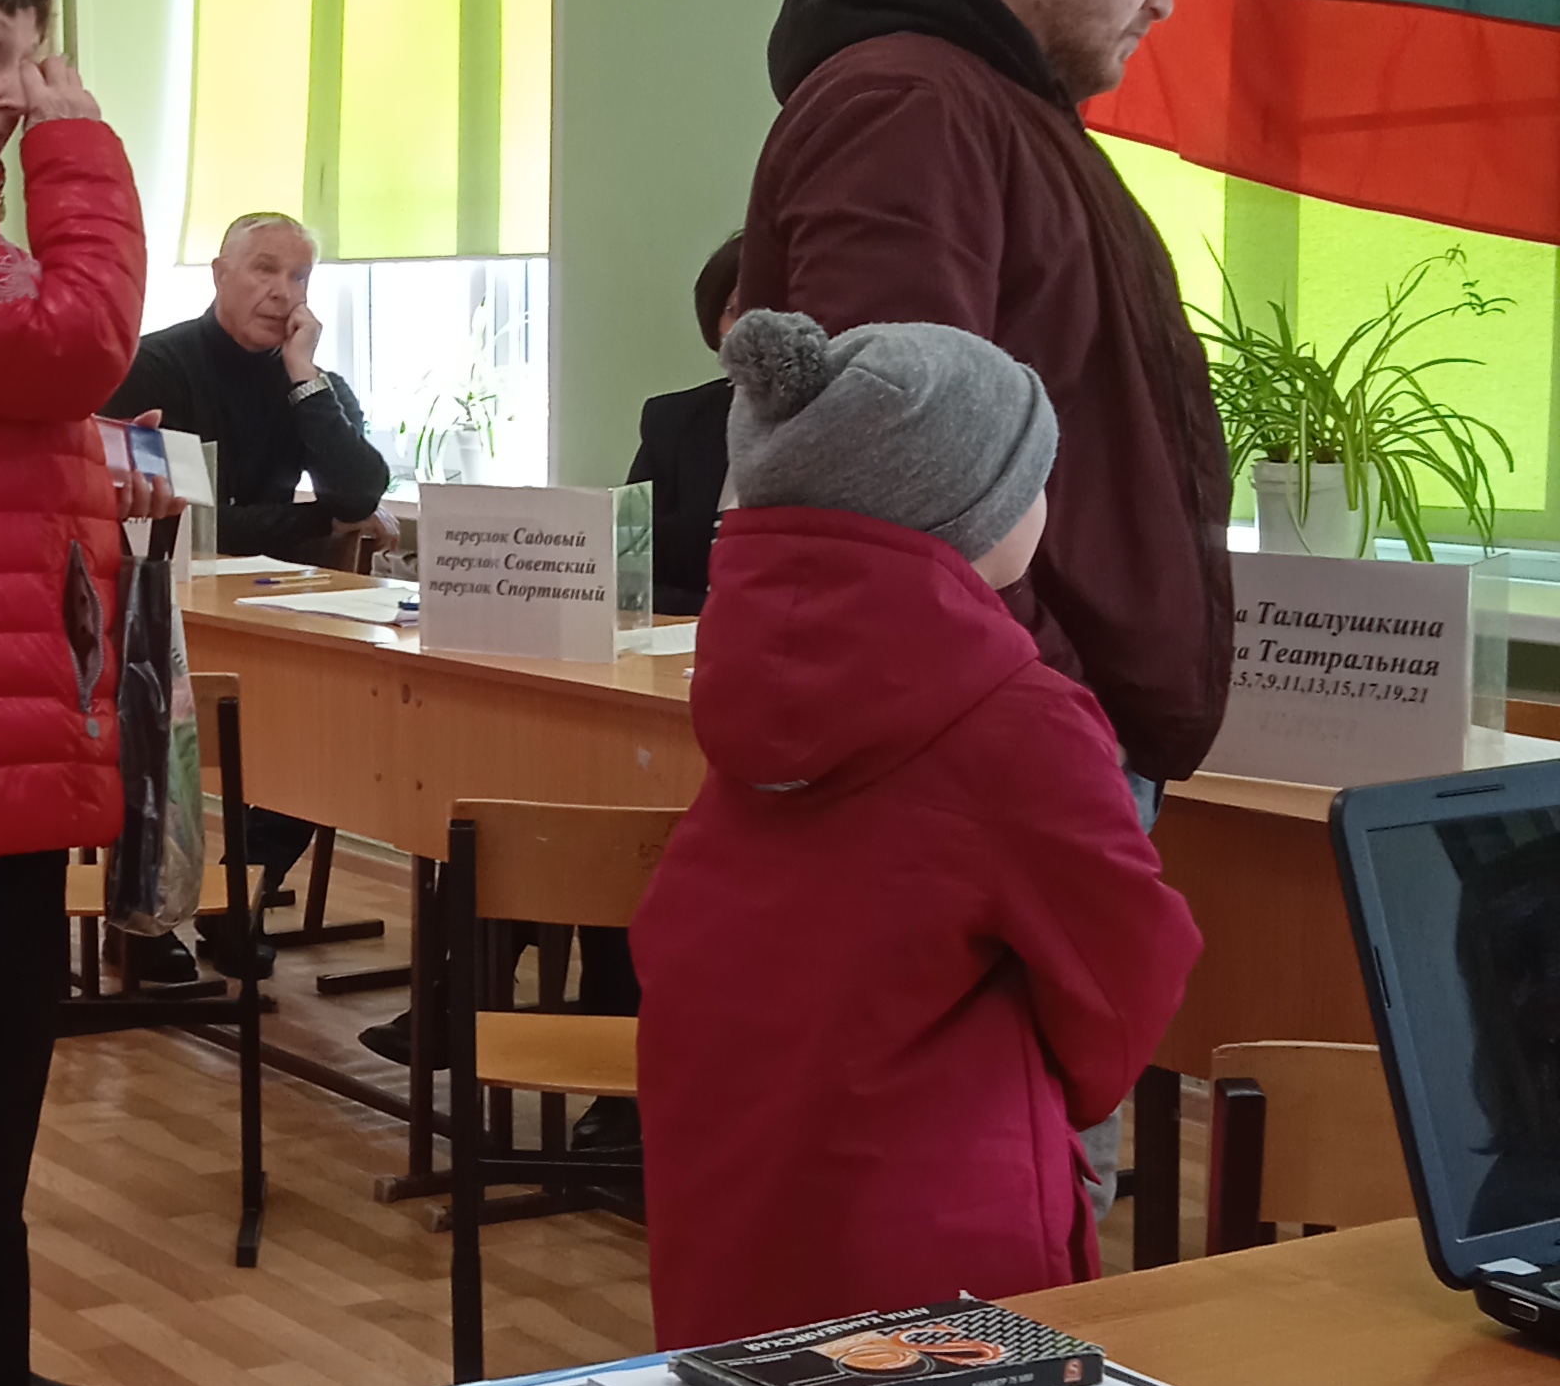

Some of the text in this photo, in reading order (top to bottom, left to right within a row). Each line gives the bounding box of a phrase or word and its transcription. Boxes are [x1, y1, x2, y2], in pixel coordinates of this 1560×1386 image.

[445, 527, 586, 548] переулок Садовый
[436, 553, 596, 575] переулок Советский
[428, 579, 605, 602] переулок Спортивный
[1258, 601, 1444, 638] Талалушкина
[1259, 639, 1440, 676] Театральная
[1231, 670, 1428, 704] ,5,7,9,11,13,15,17,19,21
